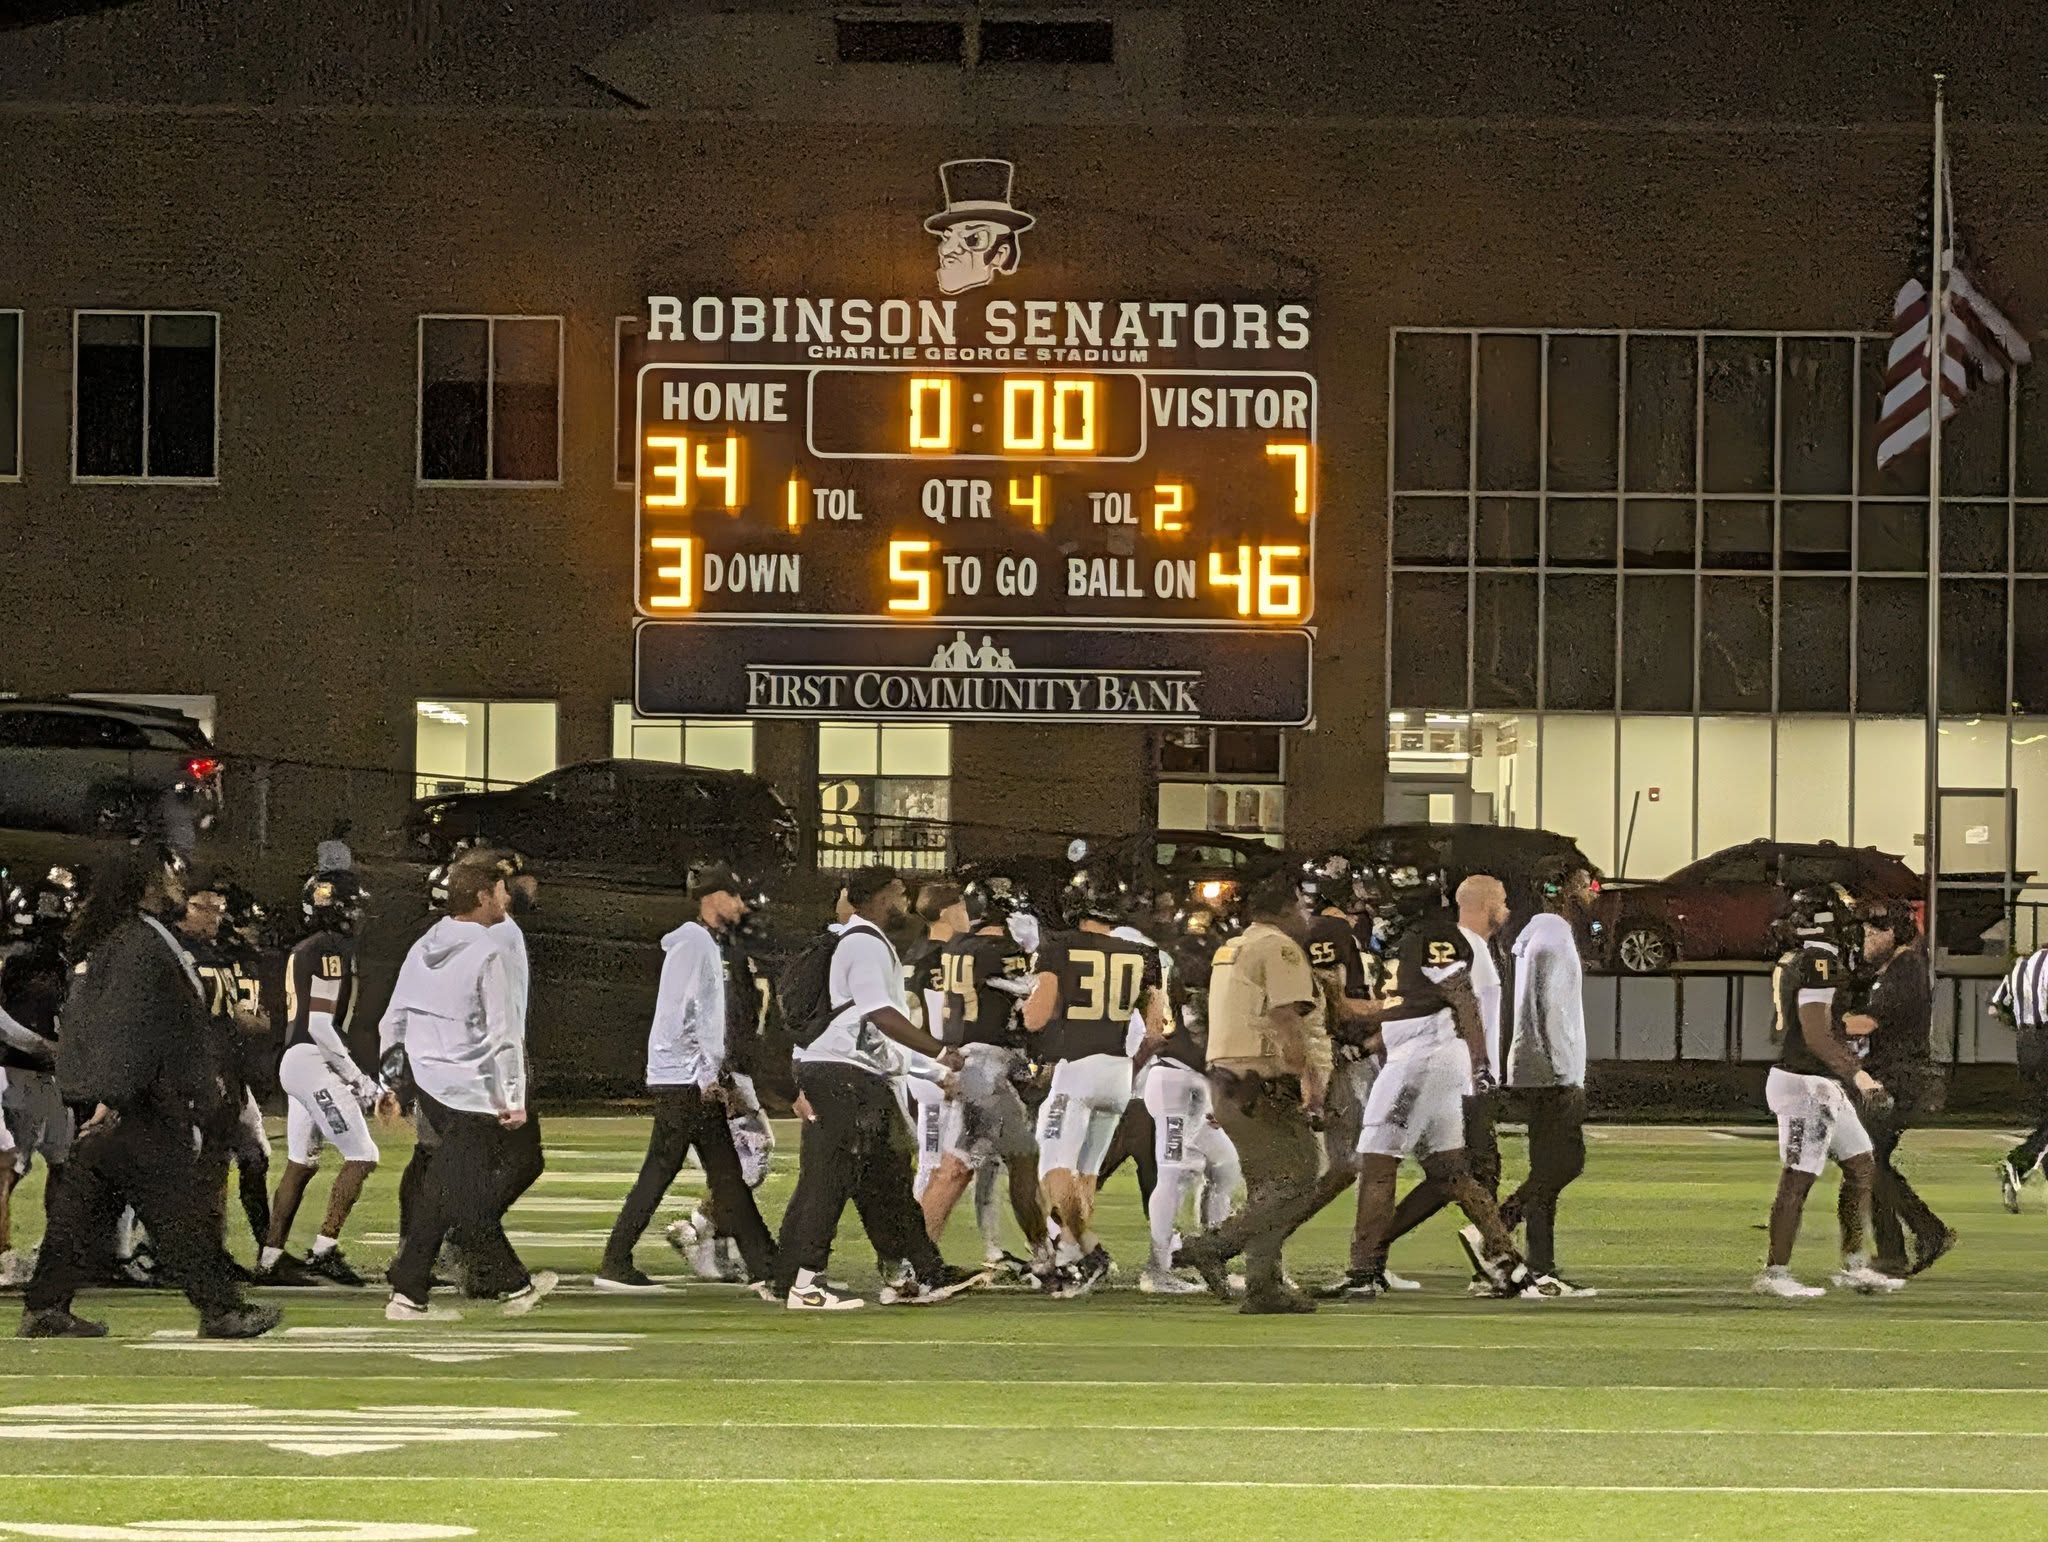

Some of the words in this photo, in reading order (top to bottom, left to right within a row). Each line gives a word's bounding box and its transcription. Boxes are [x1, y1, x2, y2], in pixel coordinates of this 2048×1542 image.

[647, 296, 957, 345] ROBINSON
[984, 300, 1310, 349] SENATORS
[808, 345, 917, 360] CHARLIE
[925, 347, 1027, 361] GEORGE
[1036, 348, 1149, 362] STADIUM
[662, 382, 788, 421] HOME
[909, 378, 1095, 450] 0:00
[1150, 388, 1308, 428] VISITOR
[646, 437, 737, 507] 34
[1266, 444, 1307, 514] 7
[787, 480, 798, 526] 1
[813, 489, 863, 520] TOL
[921, 479, 992, 523] QTR
[1009, 475, 1041, 525] 4
[1088, 492, 1139, 524] TOL
[1154, 485, 1183, 531] 2
[650, 537, 692, 608] 3
[703, 553, 800, 593] DOWN
[888, 540, 931, 610] 5
[942, 556, 982, 595] TO
[996, 557, 1038, 597] GO
[1067, 558, 1143, 598] BALL
[1154, 559, 1196, 599] ON
[1208, 545, 1301, 616] 46
[746, 671, 848, 708] FIRST
[854, 672, 1091, 711] COMMUNITY
[1097, 676, 1204, 712] BANK
[1067, 949, 1144, 1022] 30
